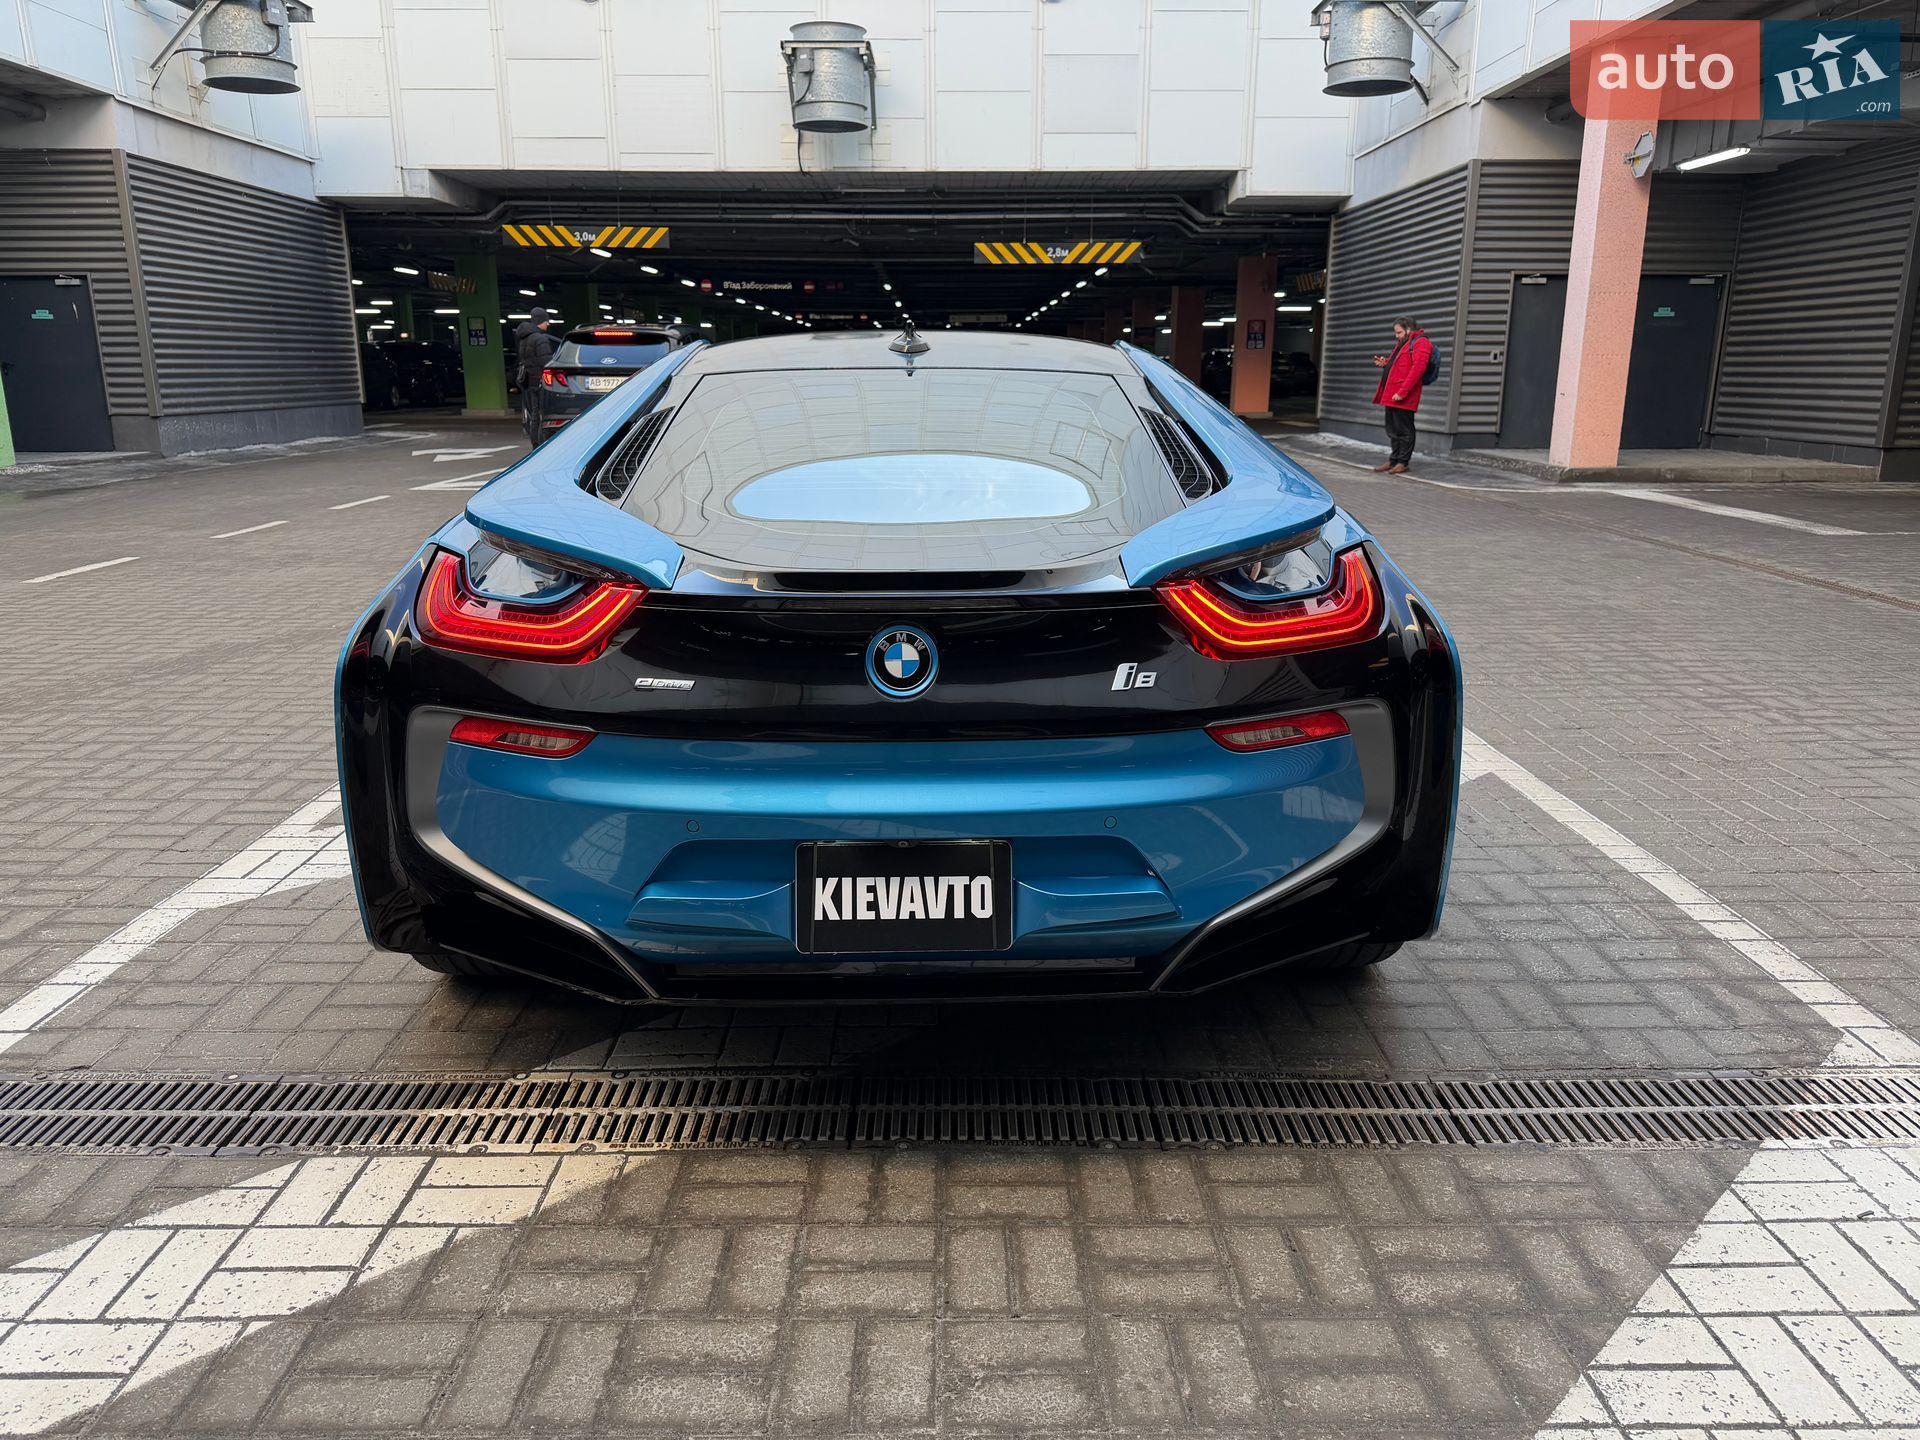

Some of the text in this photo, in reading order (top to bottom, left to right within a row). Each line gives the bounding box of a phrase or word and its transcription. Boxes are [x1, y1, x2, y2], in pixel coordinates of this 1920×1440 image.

[590, 379, 600, 387] AB
[879, 633, 926, 652] BMW
[1111, 662, 1157, 690] i8
[814, 875, 993, 920] KIEVAVTO
